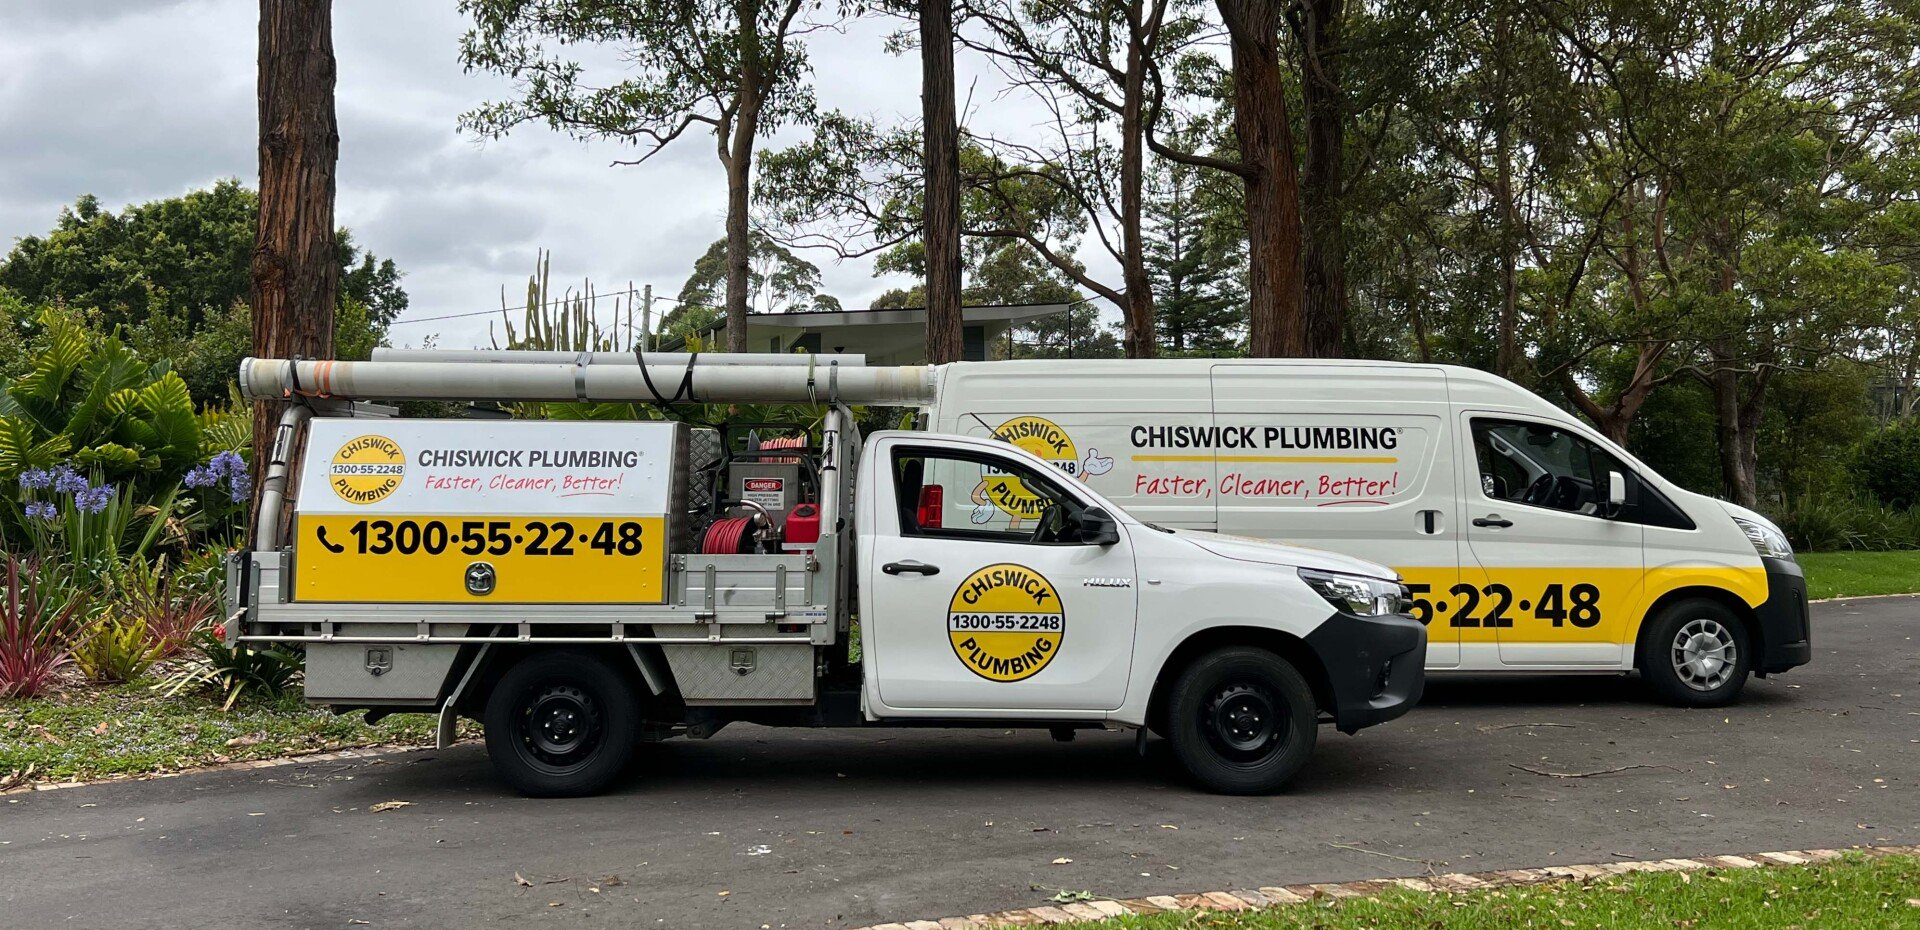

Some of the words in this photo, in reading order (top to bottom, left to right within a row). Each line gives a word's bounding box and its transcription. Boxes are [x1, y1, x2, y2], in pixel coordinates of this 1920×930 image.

[341, 438, 399, 459] CHISWICK
[999, 422, 1068, 455] HISWICK
[1130, 425, 1256, 449] CHISWICK
[418, 450, 523, 467] CHISWICK
[335, 478, 396, 501] PLUMBING
[425, 474, 483, 492] Faster,
[489, 474, 556, 492] Cleaner,
[562, 472, 624, 490] Better!
[1135, 473, 1211, 498] Faster,
[1219, 473, 1310, 499] Cleaner,
[1318, 471, 1398, 496] Better!
[992, 482, 1053, 514] PLUMB
[962, 570, 1051, 606] CHISWICK
[1083, 577, 1131, 587] HILUX
[1402, 583, 1601, 628] 5·22·48
[959, 636, 1052, 675] PLUMBING
